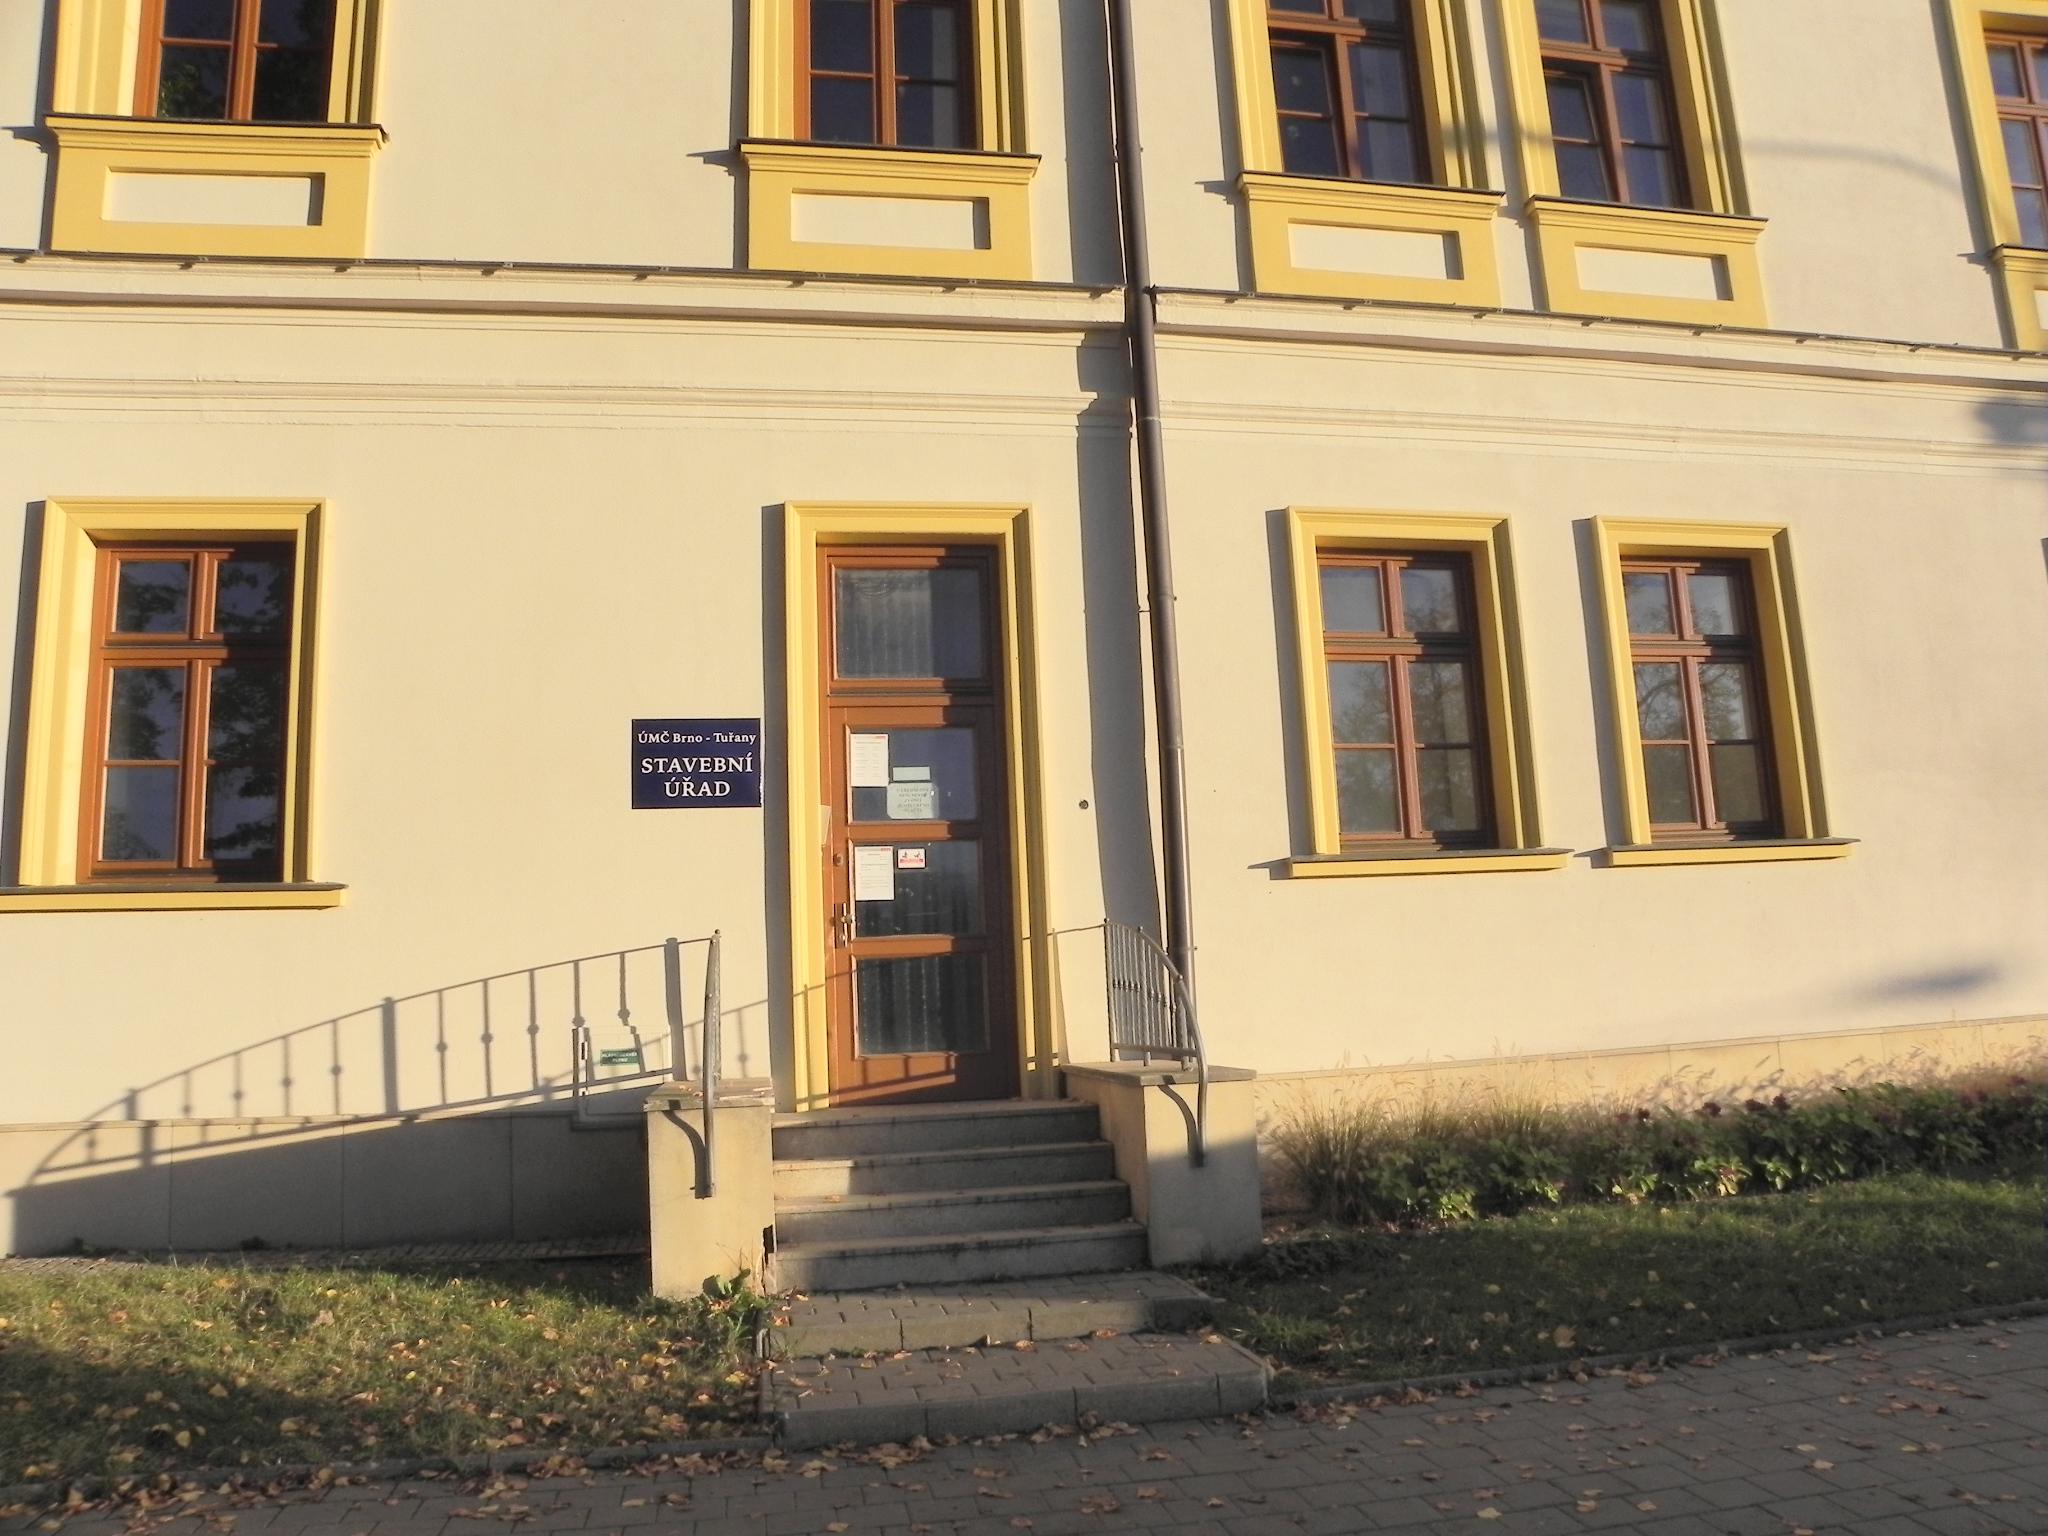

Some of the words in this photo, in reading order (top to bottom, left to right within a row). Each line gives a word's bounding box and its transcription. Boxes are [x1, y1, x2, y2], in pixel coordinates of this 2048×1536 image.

[638, 731, 670, 744] ÚMČ
[673, 732, 703, 744] Brno
[713, 732, 757, 745] Tuřany
[641, 752, 753, 774] STAVEBNÍ
[664, 776, 730, 797] ÚŘAD
